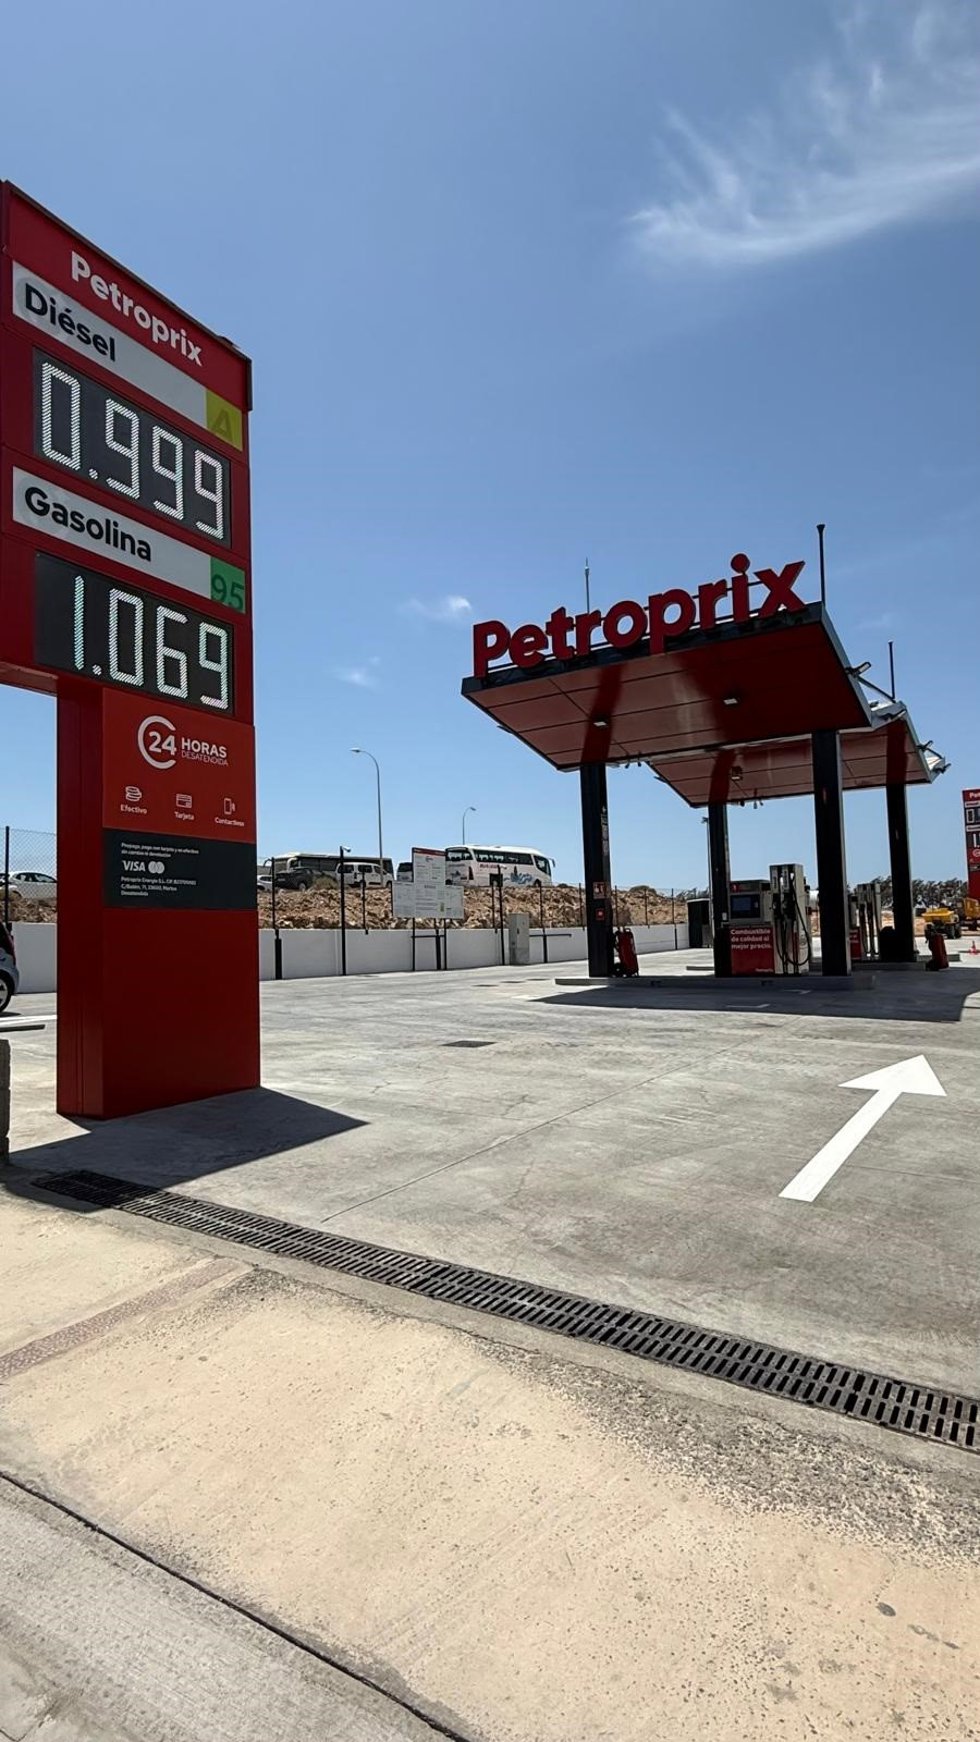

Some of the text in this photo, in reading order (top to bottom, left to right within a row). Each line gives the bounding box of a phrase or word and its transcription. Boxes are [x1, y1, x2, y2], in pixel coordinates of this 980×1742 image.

[25, 283, 116, 362] Diésel
[71, 250, 203, 367] Petroprix
[42, 362, 224, 540] 0.999
[212, 409, 233, 441] A
[25, 487, 152, 562] Gasolina
[211, 574, 245, 611] 95
[473, 552, 806, 678] Petroprix
[74, 575, 228, 710] 1.069
[149, 731, 227, 758] 24 HORAS
[181, 750, 229, 767] DESATENDIDA
[122, 860, 146, 872] VISA
